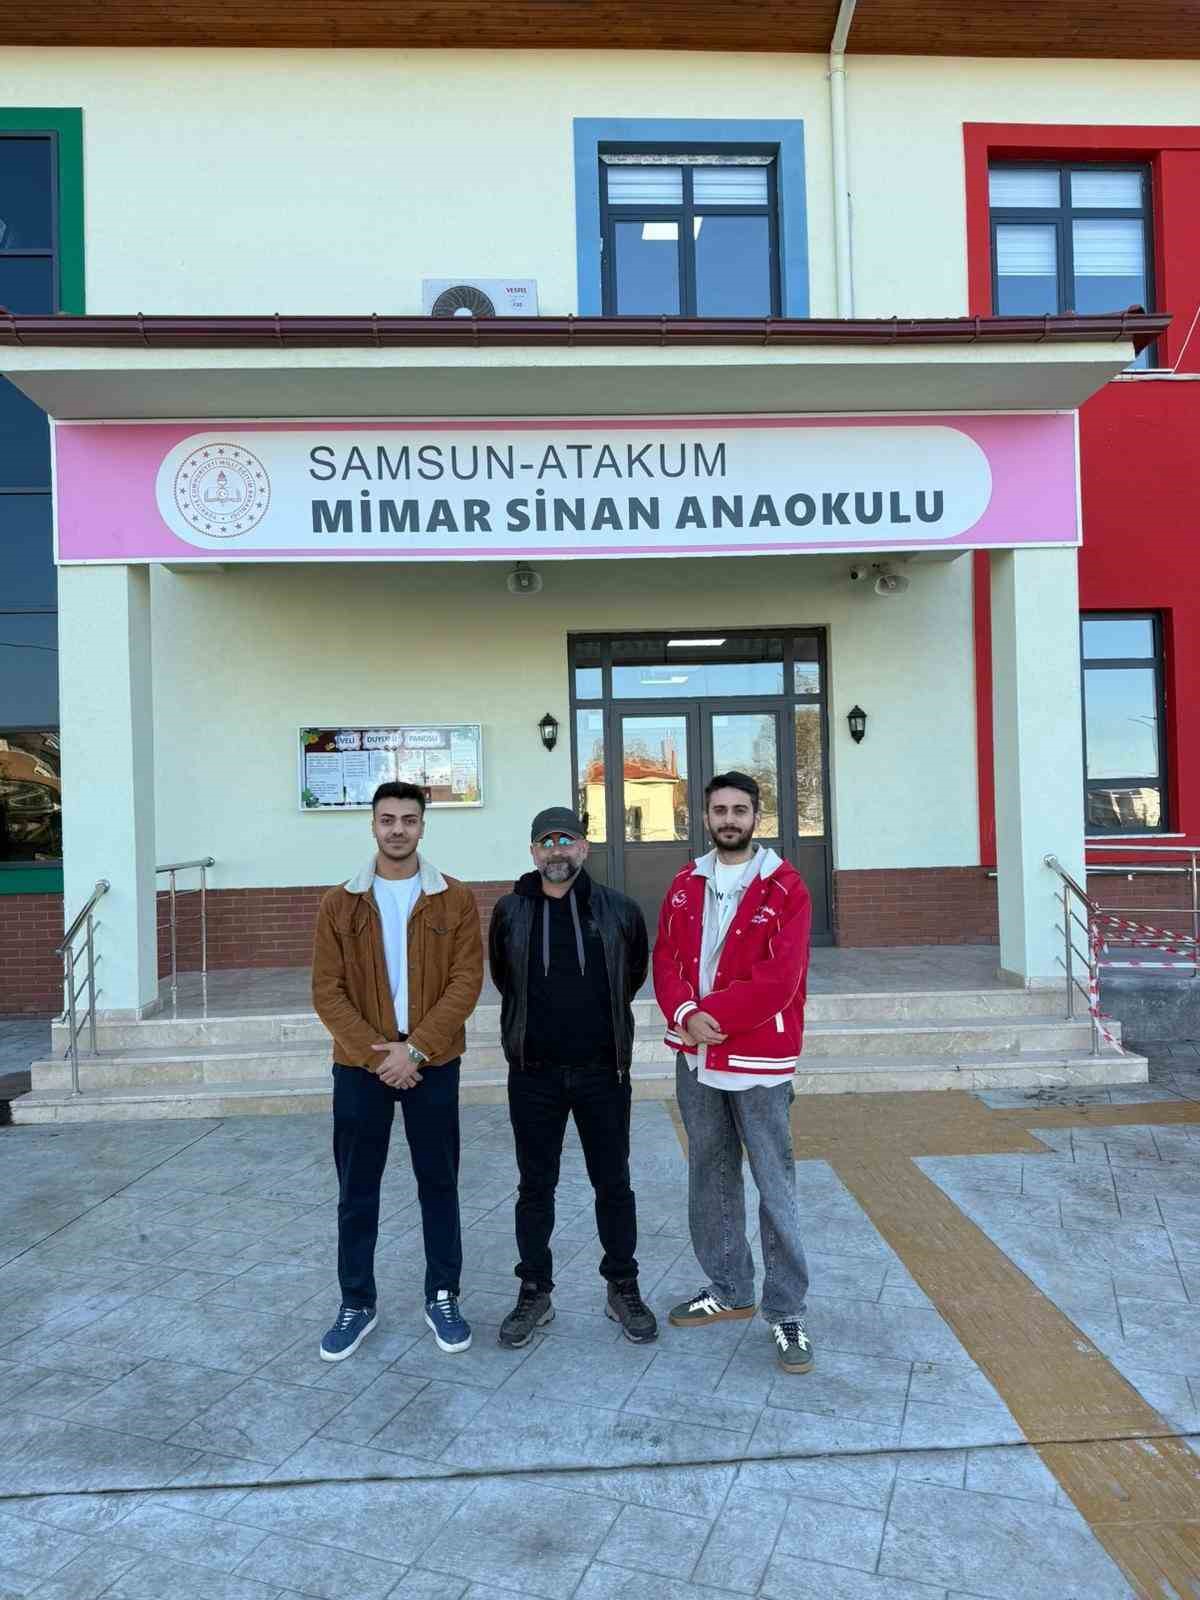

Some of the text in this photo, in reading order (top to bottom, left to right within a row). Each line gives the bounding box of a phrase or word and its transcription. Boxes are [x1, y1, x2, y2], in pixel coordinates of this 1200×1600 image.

[310, 442, 726, 481] SAMSUN-ATAKUM
[312, 488, 944, 533] MİMAR SİNAN ANAOKULU
